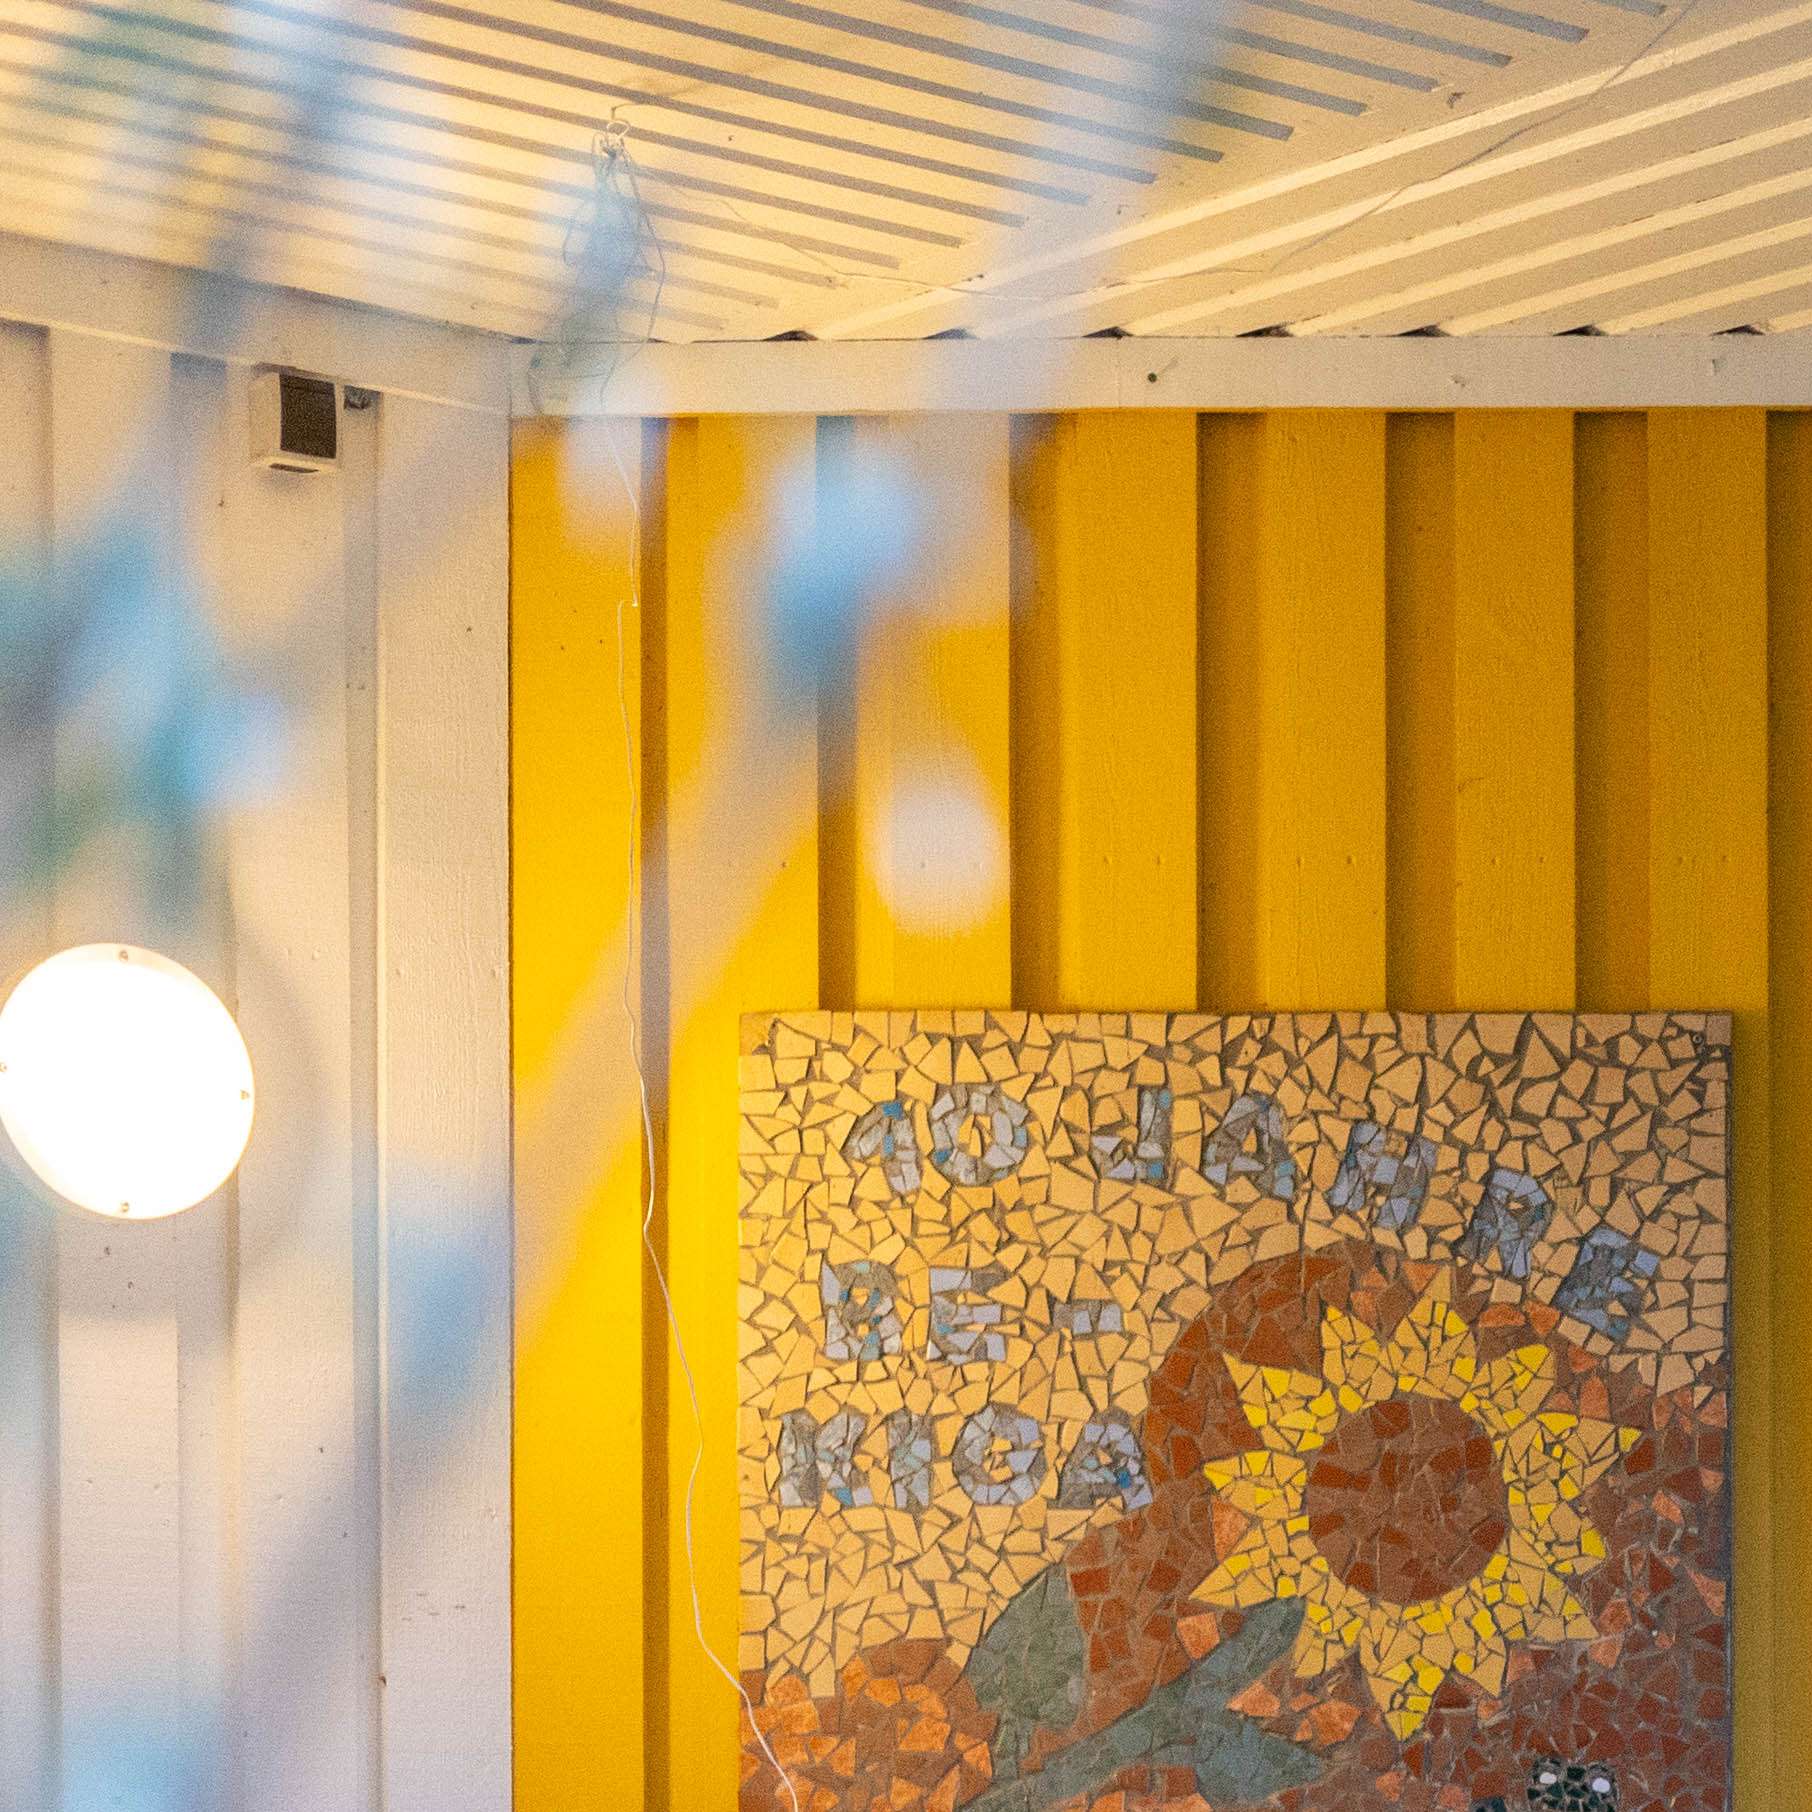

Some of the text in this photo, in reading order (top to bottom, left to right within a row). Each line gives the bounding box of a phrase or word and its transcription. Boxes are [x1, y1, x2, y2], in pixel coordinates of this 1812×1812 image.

[847, 1082, 1658, 1340] 10 JAHRE
[779, 1402, 1153, 1508] KIGA
